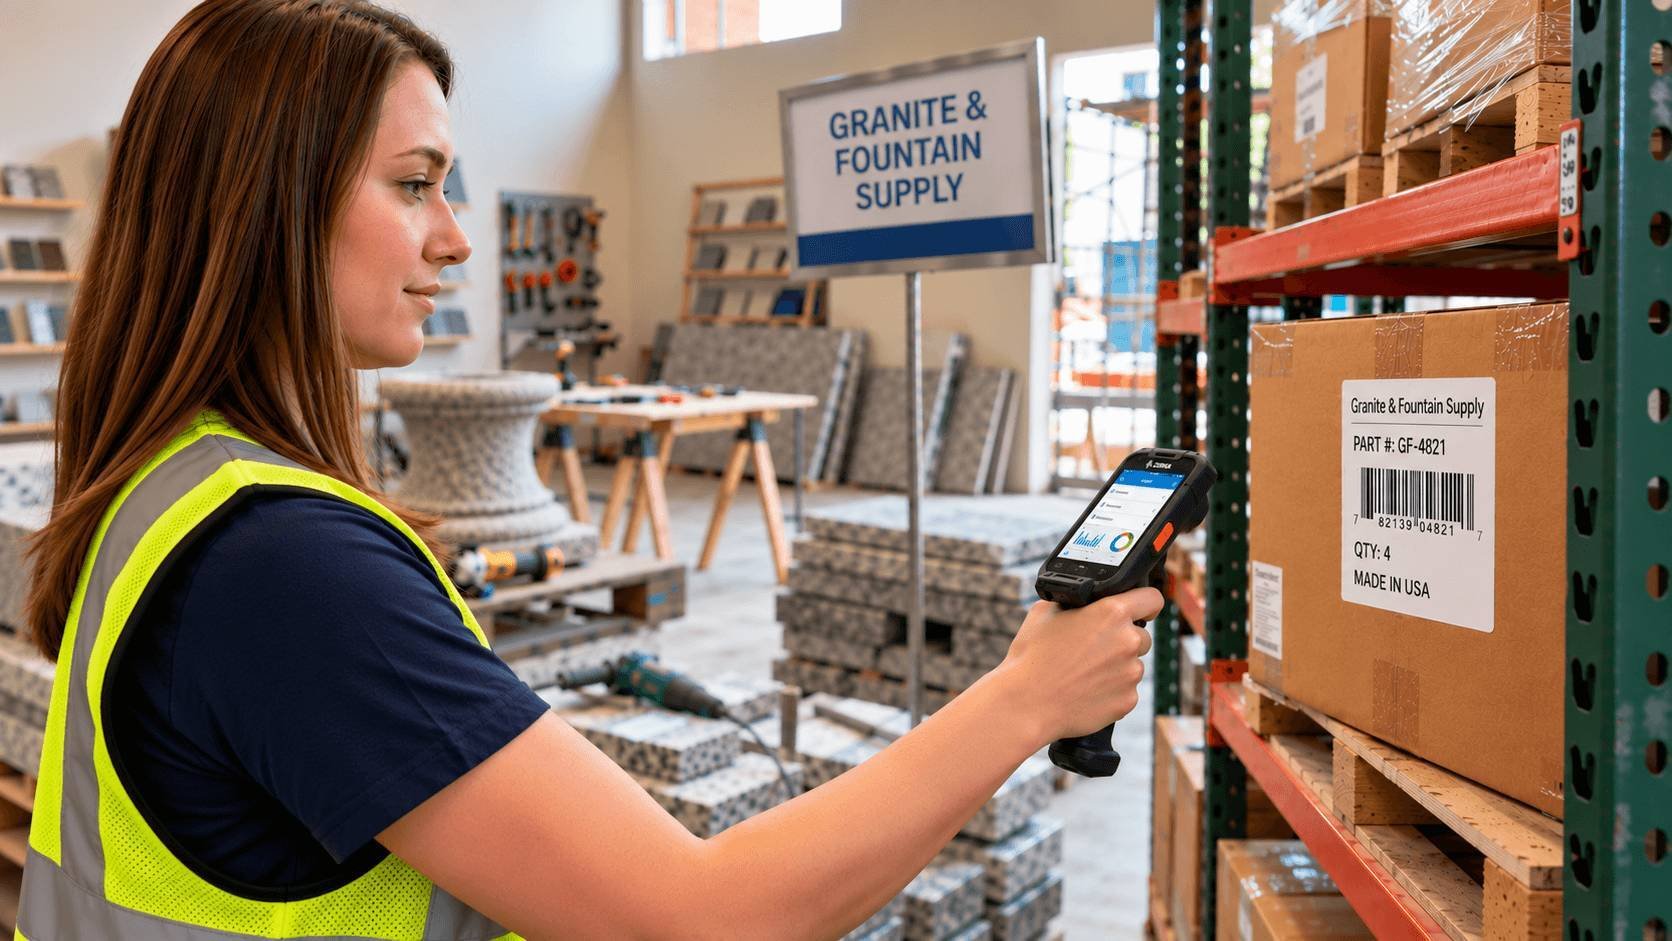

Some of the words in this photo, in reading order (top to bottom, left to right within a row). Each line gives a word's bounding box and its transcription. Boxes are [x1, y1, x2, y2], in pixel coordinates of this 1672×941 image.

[830, 95, 957, 139] GRANITE
[966, 91, 987, 120] &
[836, 131, 981, 175] FOUNTAIN
[857, 173, 963, 210] SUPPLY
[1350, 397, 1386, 414] Granite
[1388, 397, 1397, 414] &
[1398, 396, 1444, 415] Fountain
[1446, 396, 1485, 420] Supply
[1353, 435, 1382, 453] PART
[1384, 436, 1395, 454] #:
[1397, 436, 1446, 456] GF-4821
[1353, 513, 1360, 525] 7
[1378, 516, 1413, 531] 82139
[1419, 520, 1455, 537] 04821
[1477, 530, 1484, 542] 7
[1353, 540, 1381, 560] QTY:
[1383, 544, 1391, 562] 4
[1353, 569, 1387, 591] MADE
[1389, 575, 1402, 594] IN
[1404, 577, 1431, 599] USA
